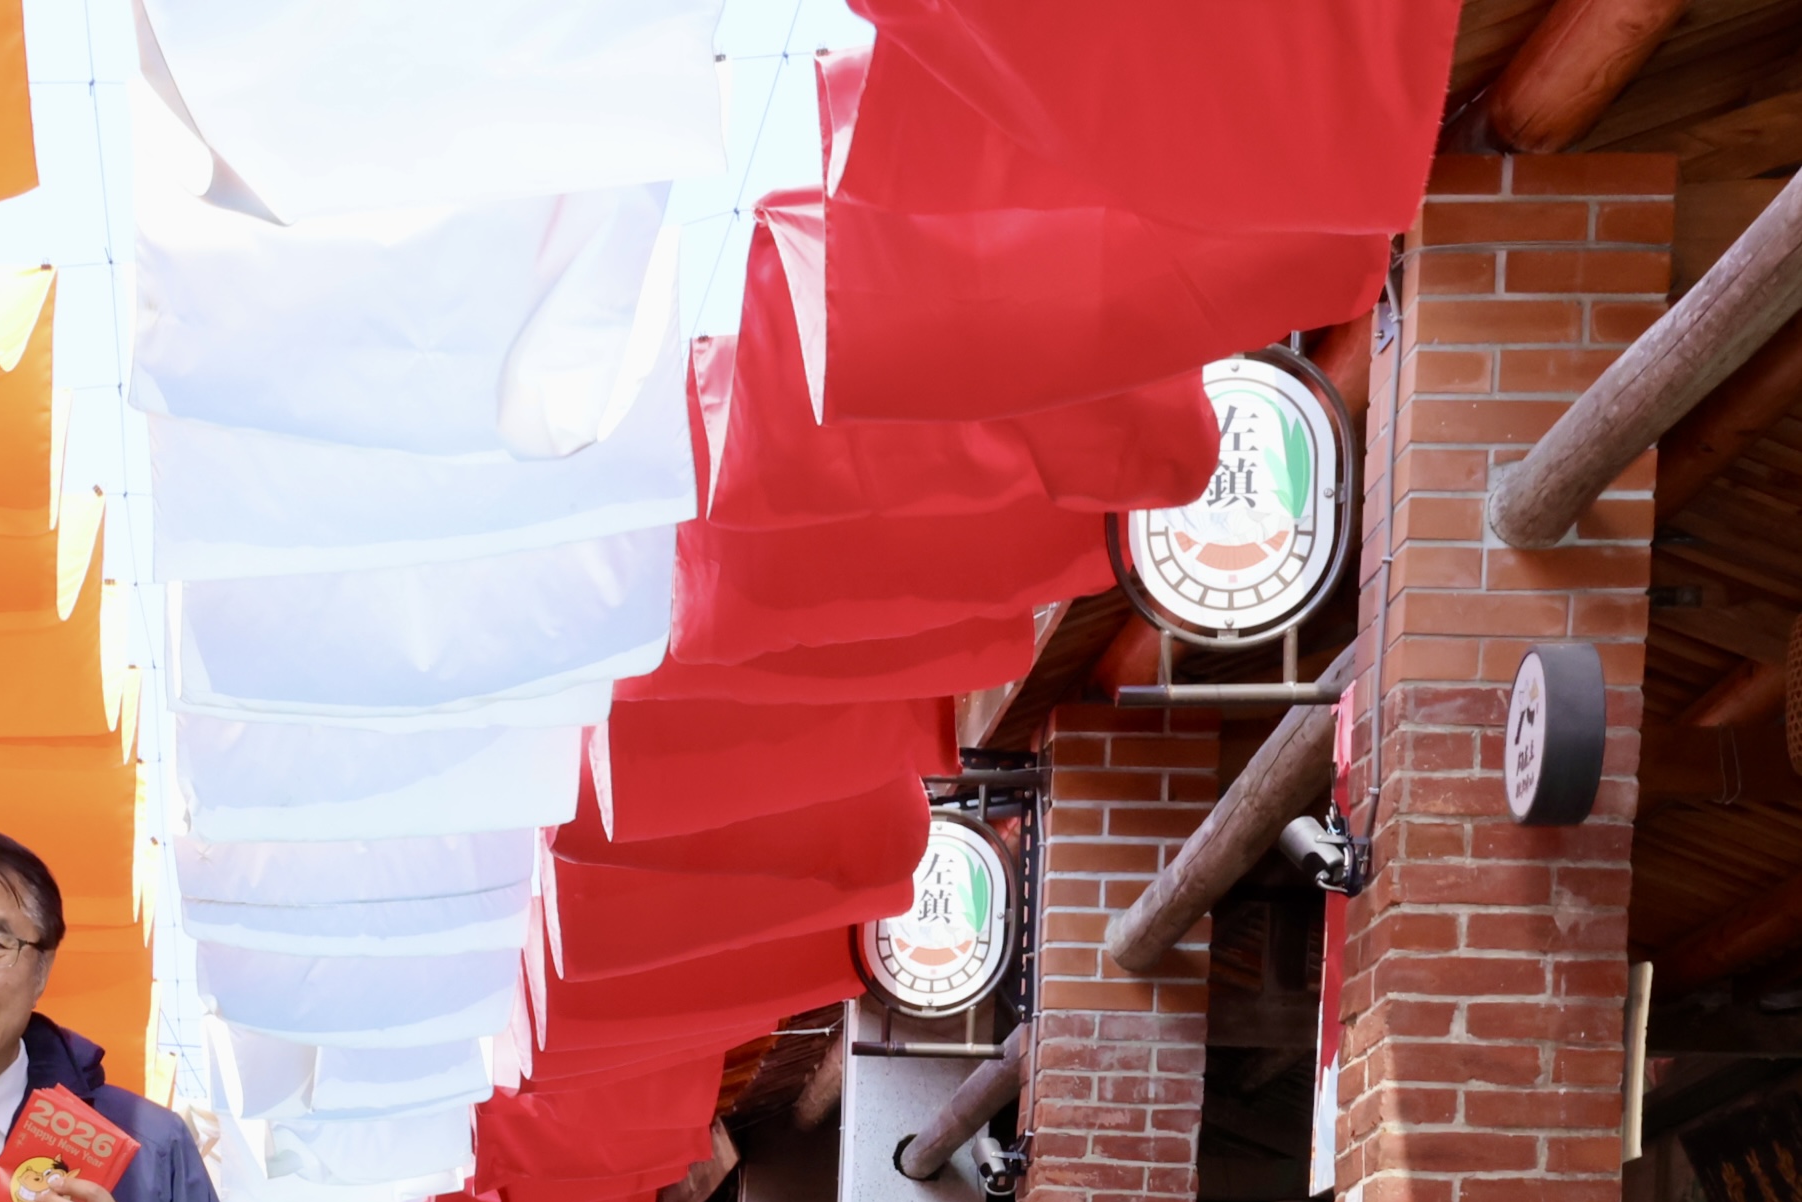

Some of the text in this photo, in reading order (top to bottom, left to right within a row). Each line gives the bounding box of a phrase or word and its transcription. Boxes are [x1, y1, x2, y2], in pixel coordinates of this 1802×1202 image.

[1206, 404, 1260, 509] 左鎮
[917, 852, 954, 924] 左鎮
[23, 1119, 104, 1168] Happy New Year
[28, 1099, 116, 1158] 2026
